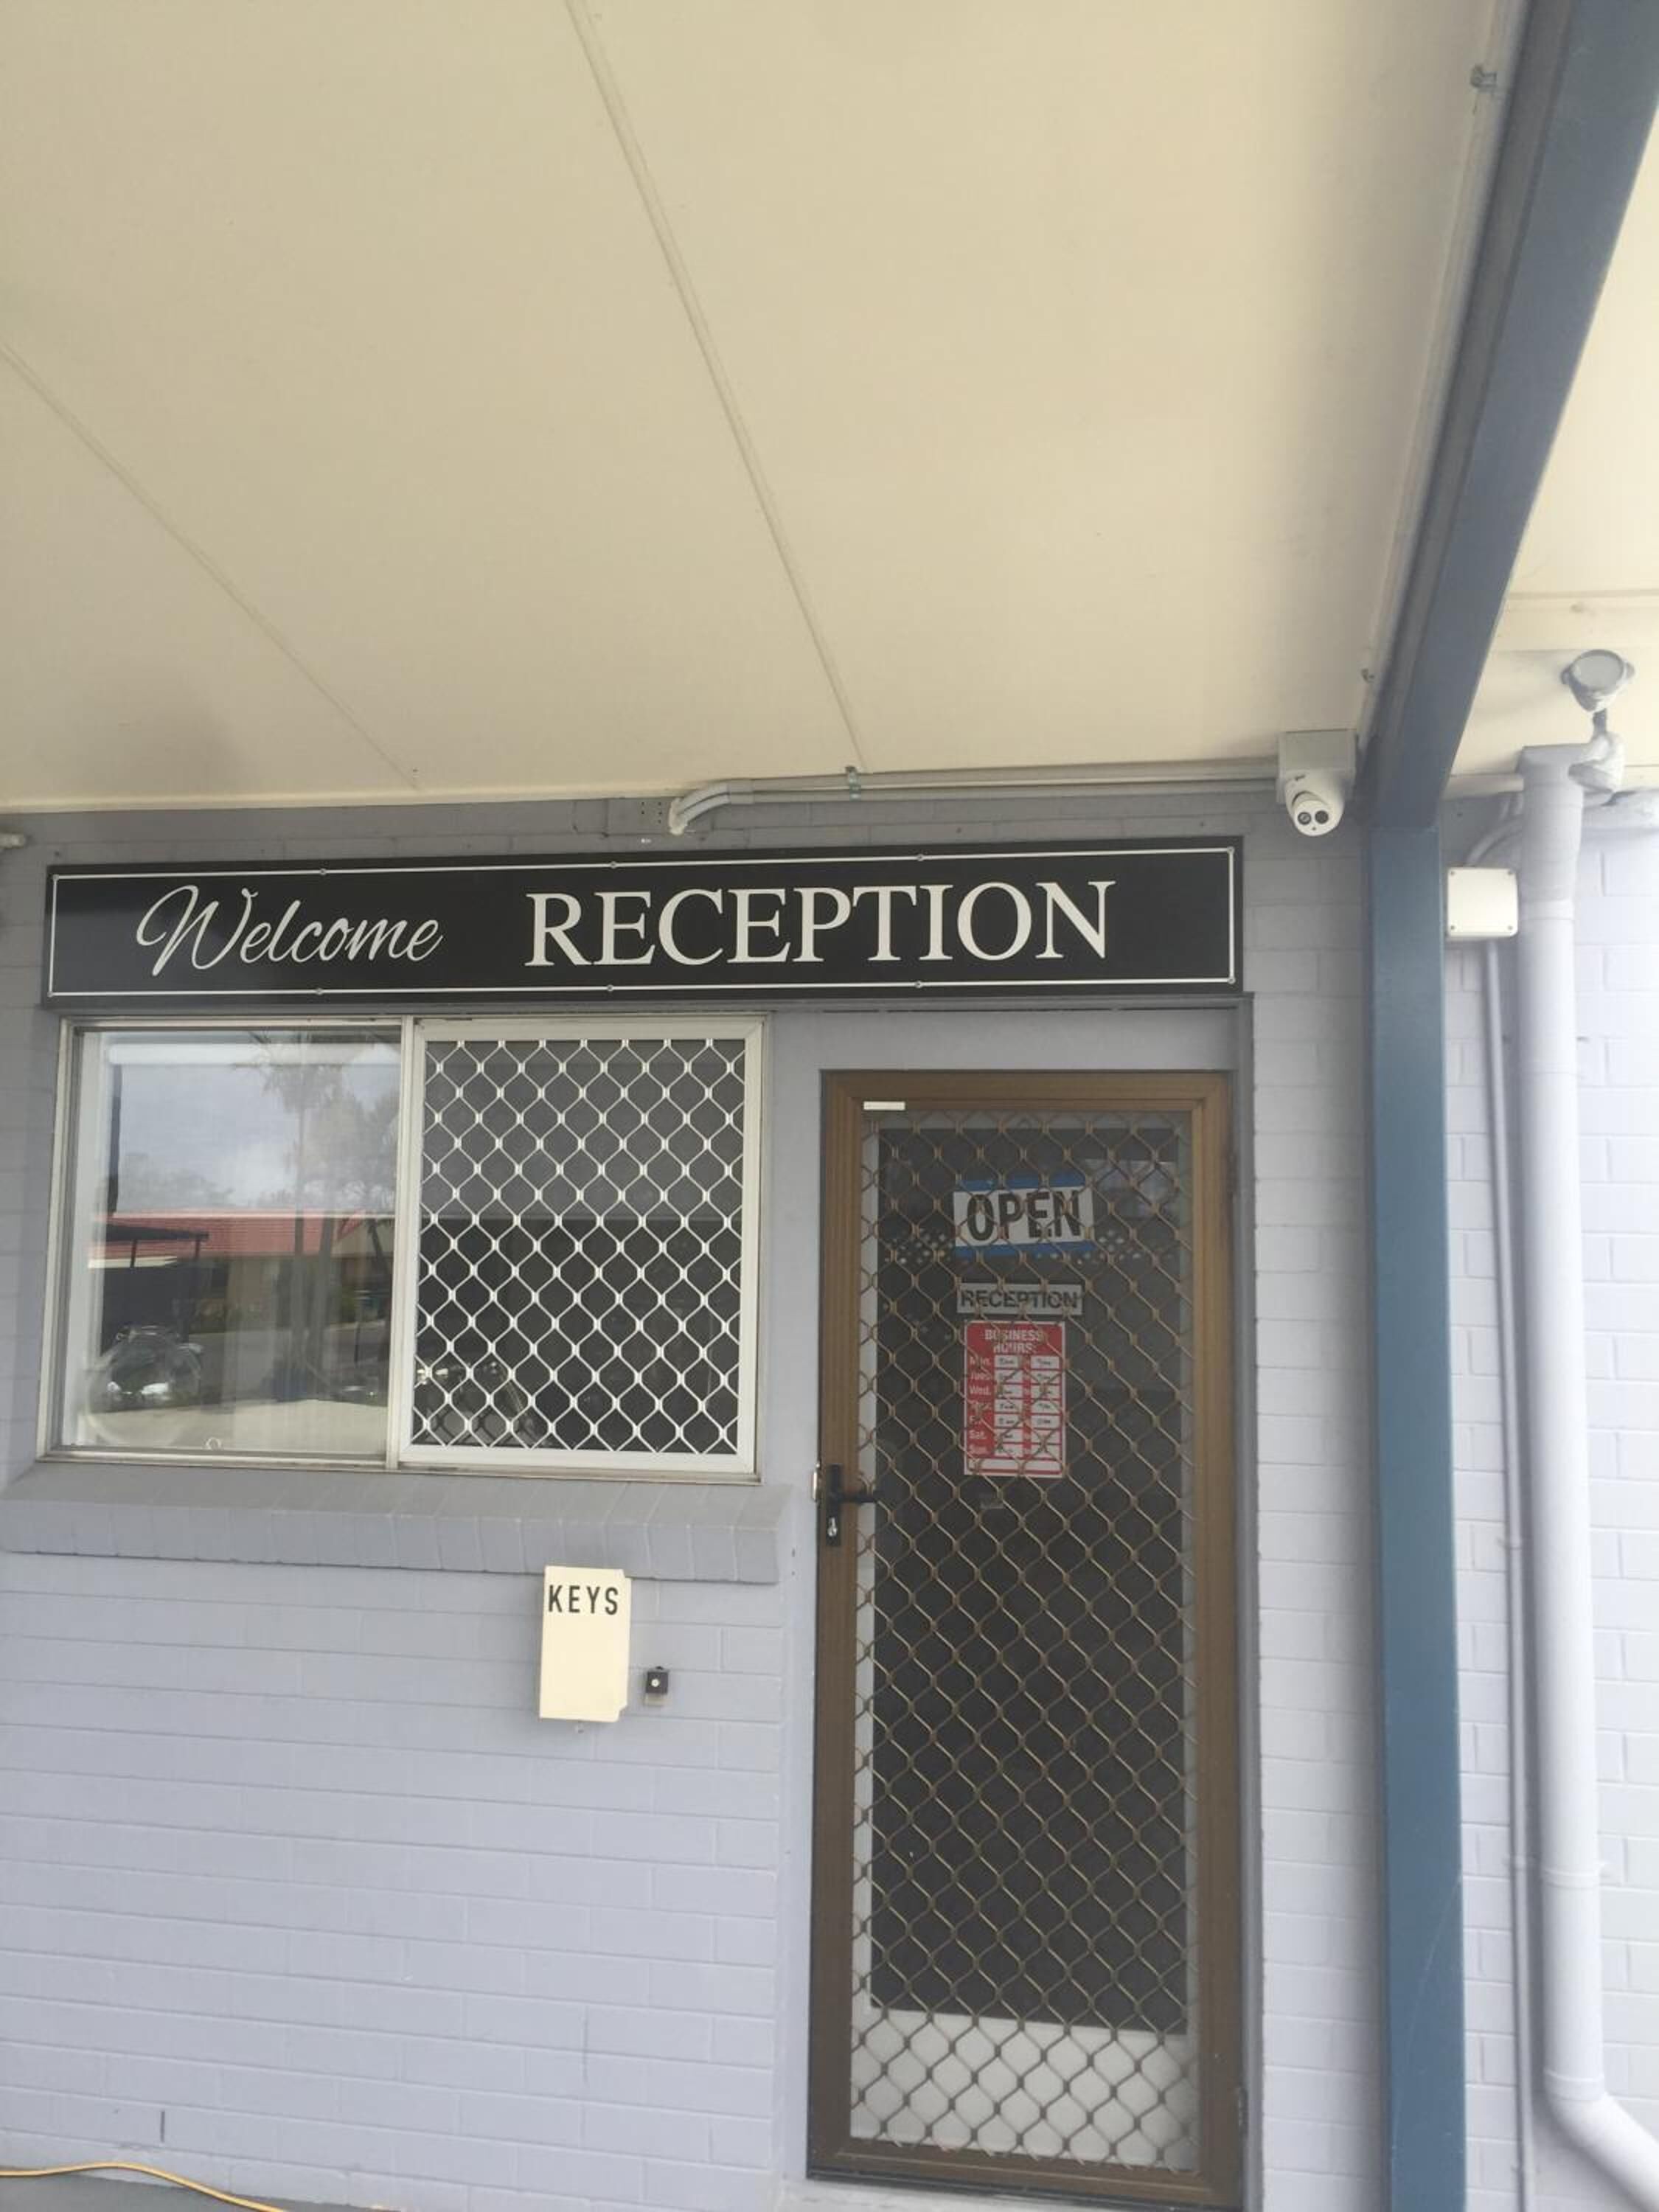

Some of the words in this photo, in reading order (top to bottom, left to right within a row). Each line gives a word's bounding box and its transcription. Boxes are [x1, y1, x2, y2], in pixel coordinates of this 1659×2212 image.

[136, 884, 444, 976] Welcome
[524, 880, 1116, 967] RECEPTION
[967, 1190, 1081, 1241] OPEN
[961, 1290, 1078, 1309] RECEPTION
[549, 1585, 619, 1615] KEYS
